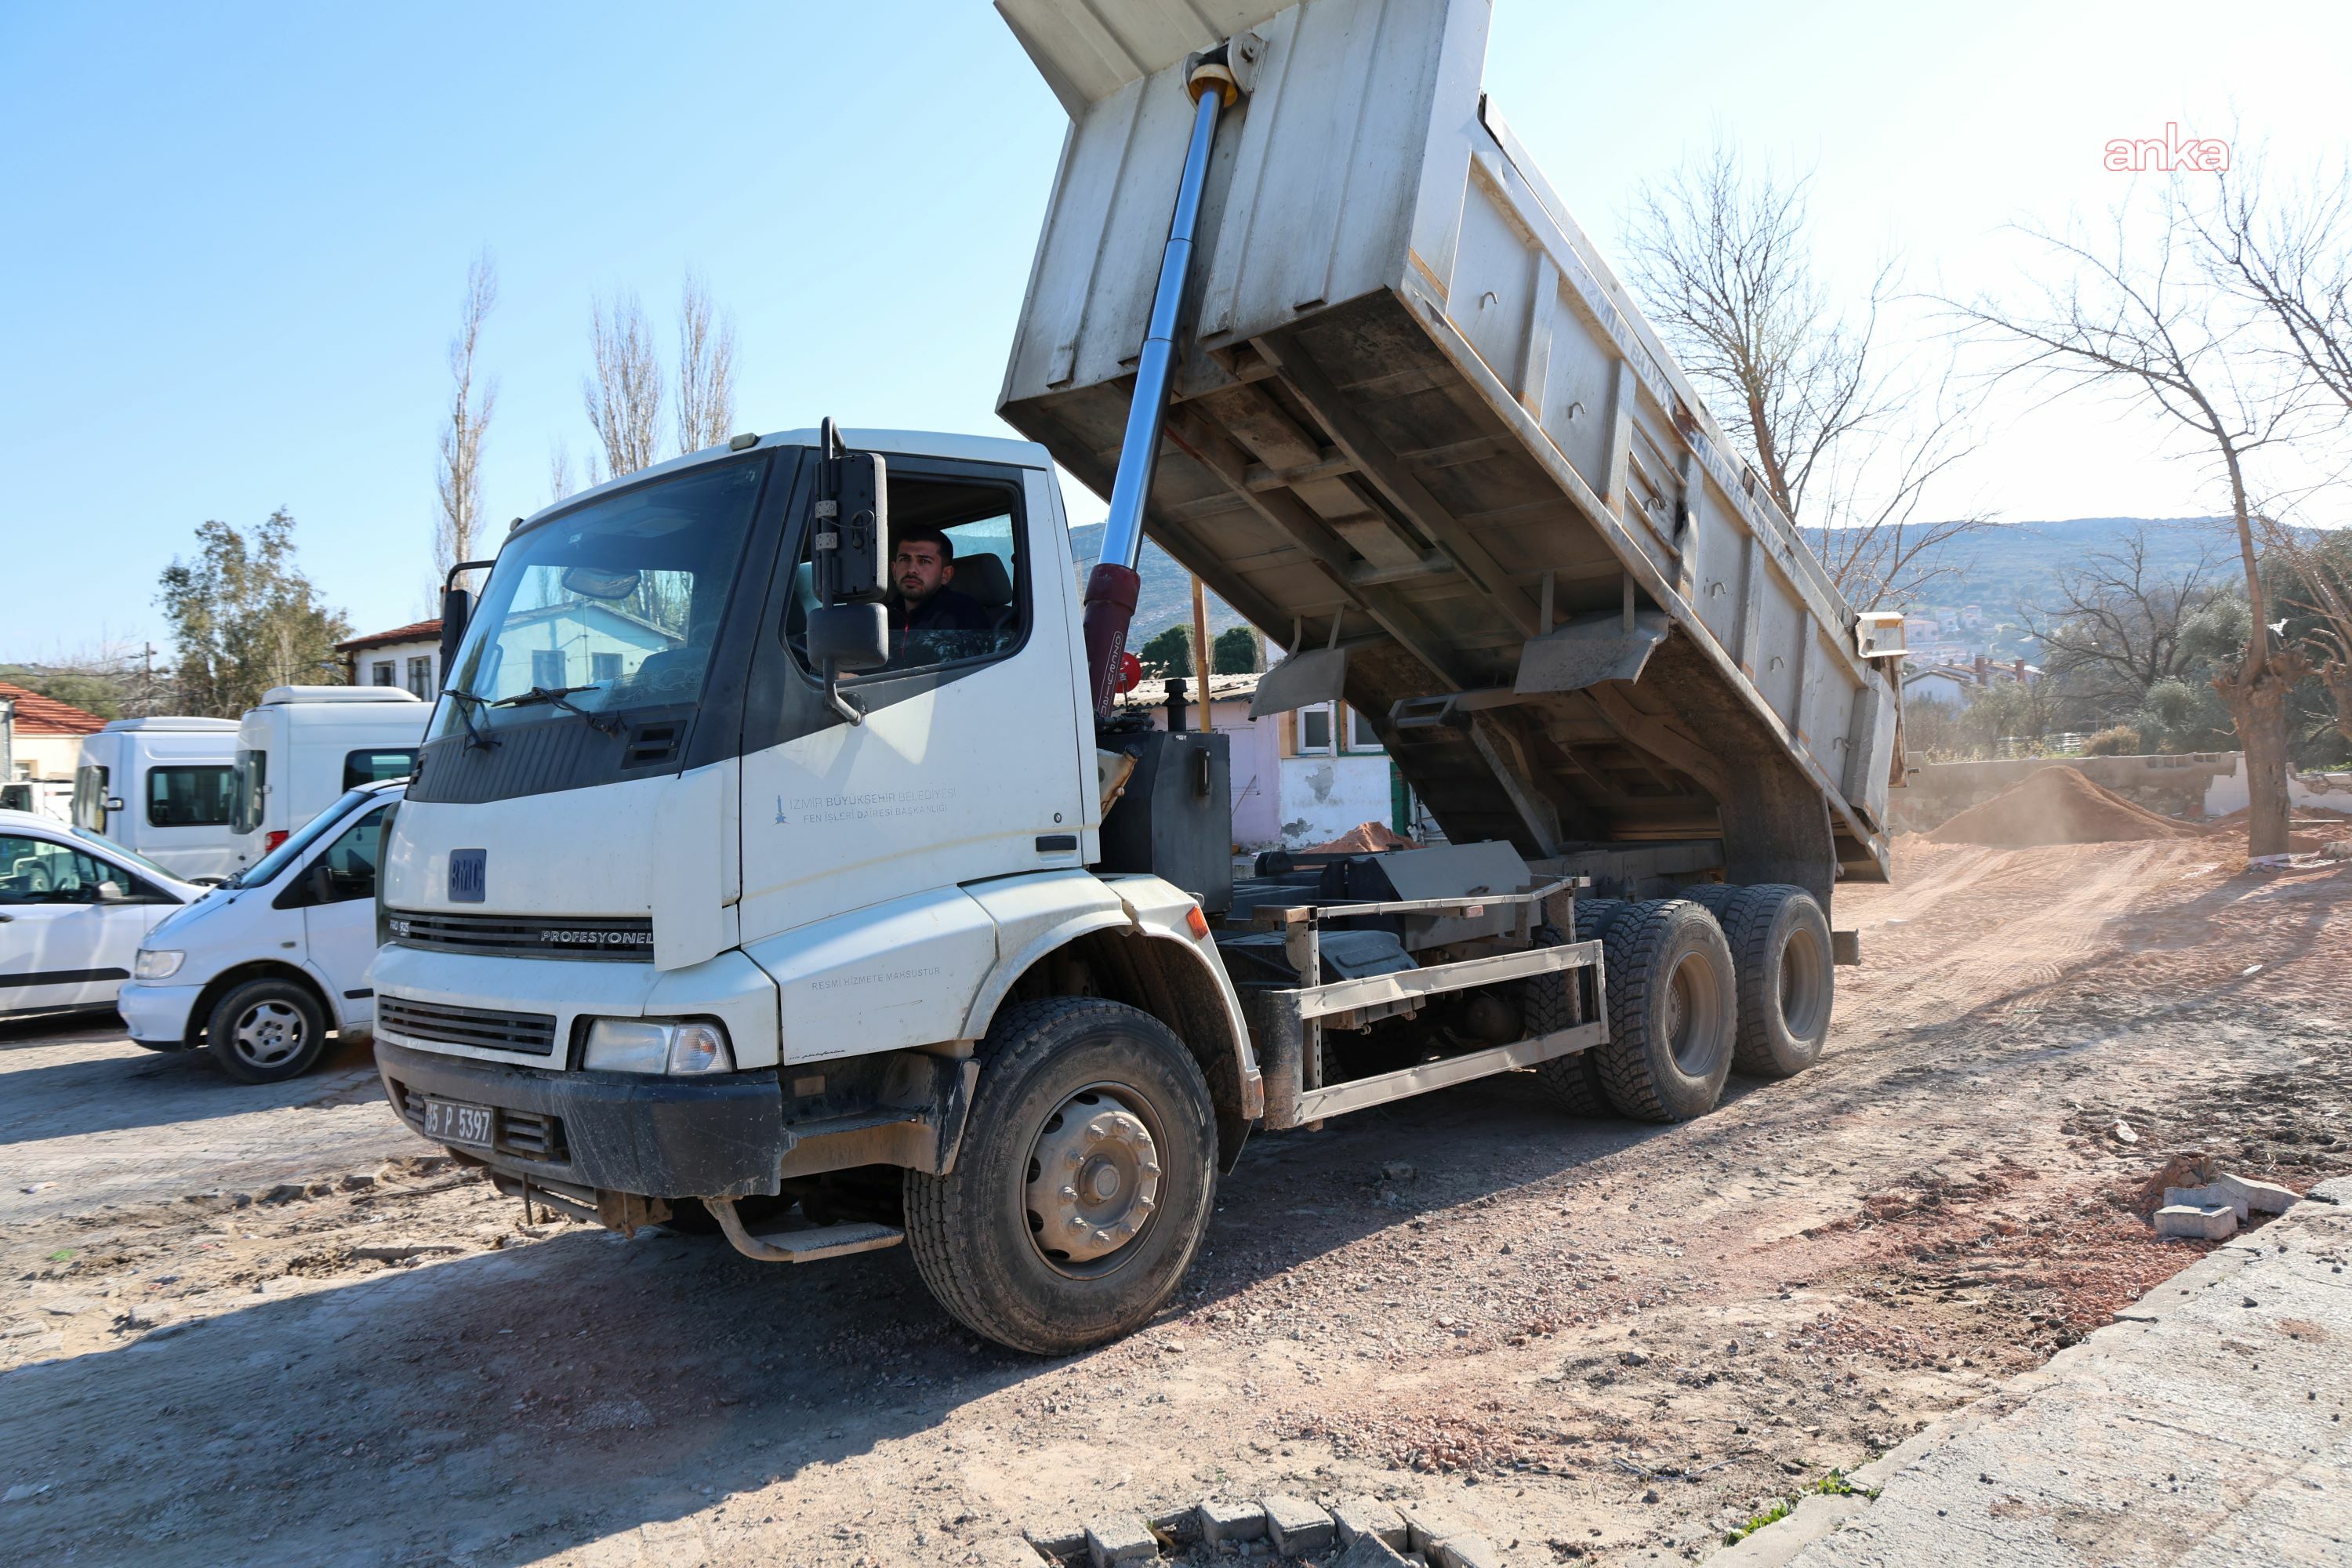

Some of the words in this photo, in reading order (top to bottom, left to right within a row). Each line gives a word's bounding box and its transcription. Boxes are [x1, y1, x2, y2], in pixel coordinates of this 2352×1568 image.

[803, 814, 822, 824] FEN
[451, 858, 483, 892] BMC
[540, 930, 654, 945] PROFESYONEL
[886, 967, 941, 982] MAHSUSTUR
[445, 1106, 452, 1135] P
[459, 1108, 490, 1142] 5397
